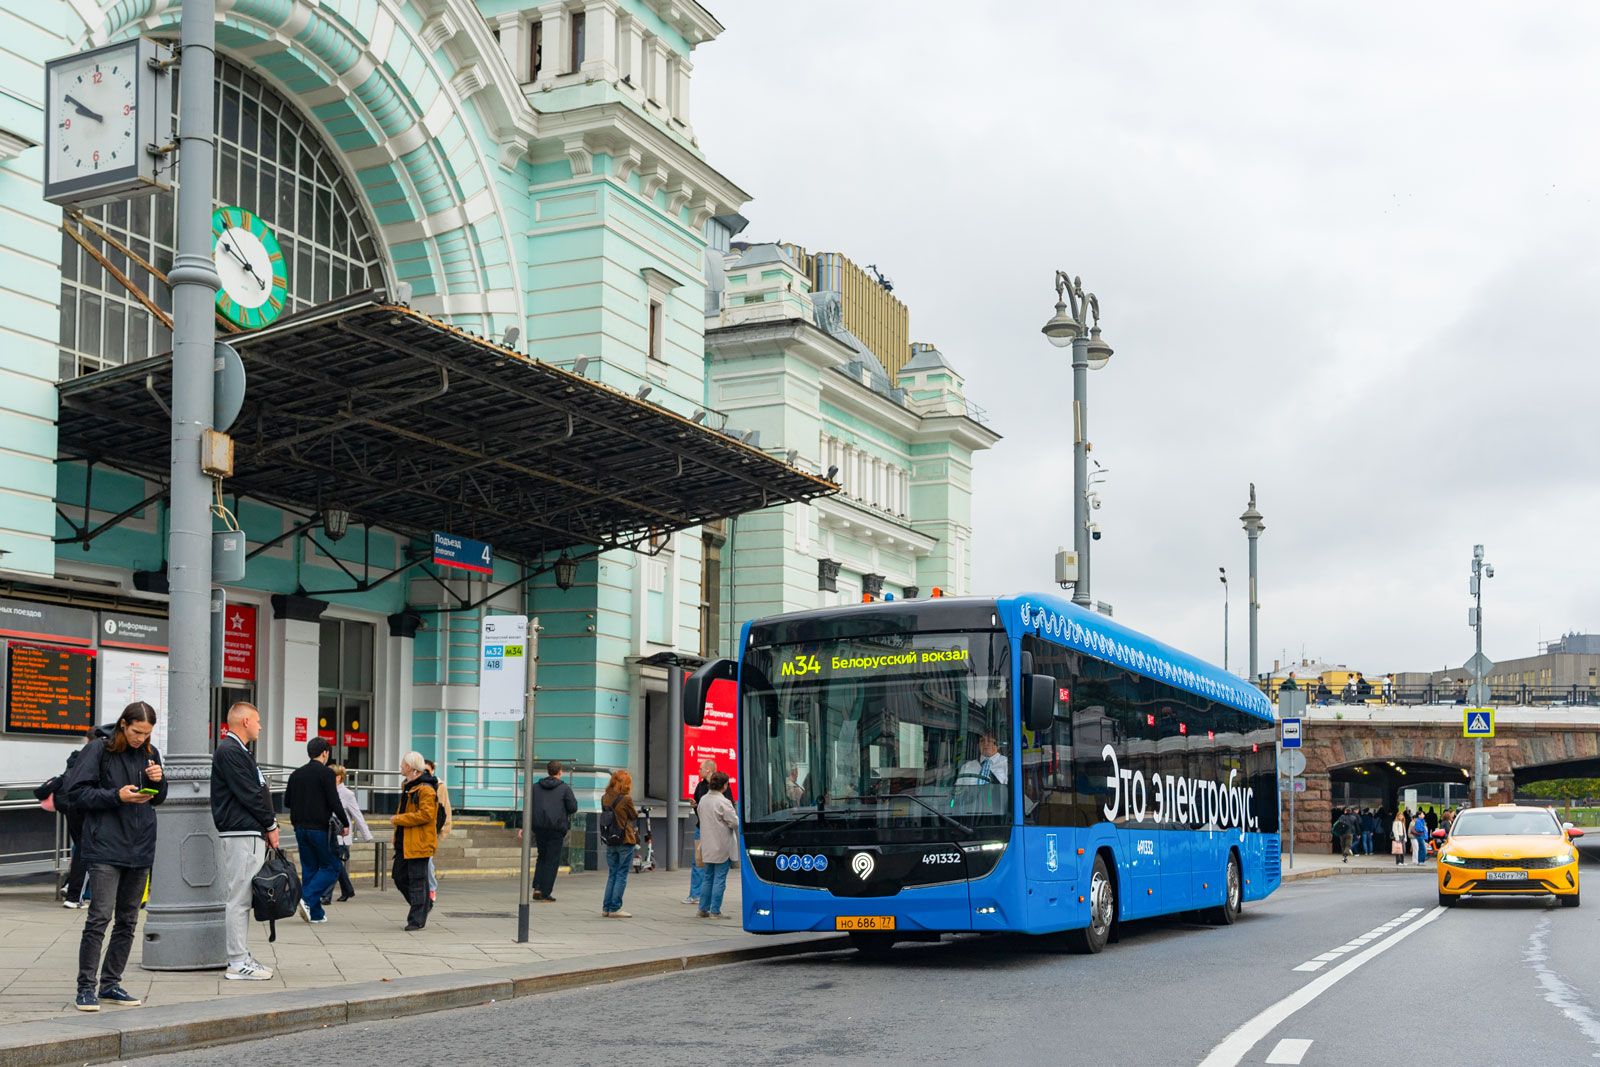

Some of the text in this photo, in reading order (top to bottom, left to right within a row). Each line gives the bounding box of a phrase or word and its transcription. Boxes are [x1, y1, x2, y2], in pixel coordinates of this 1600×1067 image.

[92, 72, 102, 84] 12
[123, 104, 130, 116] 3
[64, 118, 71, 130] 9
[92, 151, 99, 162] 6
[435, 533, 462, 549] Подъезд
[481, 545, 490, 564] 4
[13, 608, 42, 617] поездов
[118, 620, 158, 632] Информация
[487, 660, 500, 669] 418
[831, 651, 917, 670] Белорусский
[921, 649, 969, 663] вокзал
[1101, 744, 1259, 843] Это электробус.
[1137, 839, 1154, 855] 491332
[922, 852, 961, 864] 491332
[841, 920, 853, 928] НО
[857, 917, 875, 928] 686
[881, 917, 891, 925] 77
